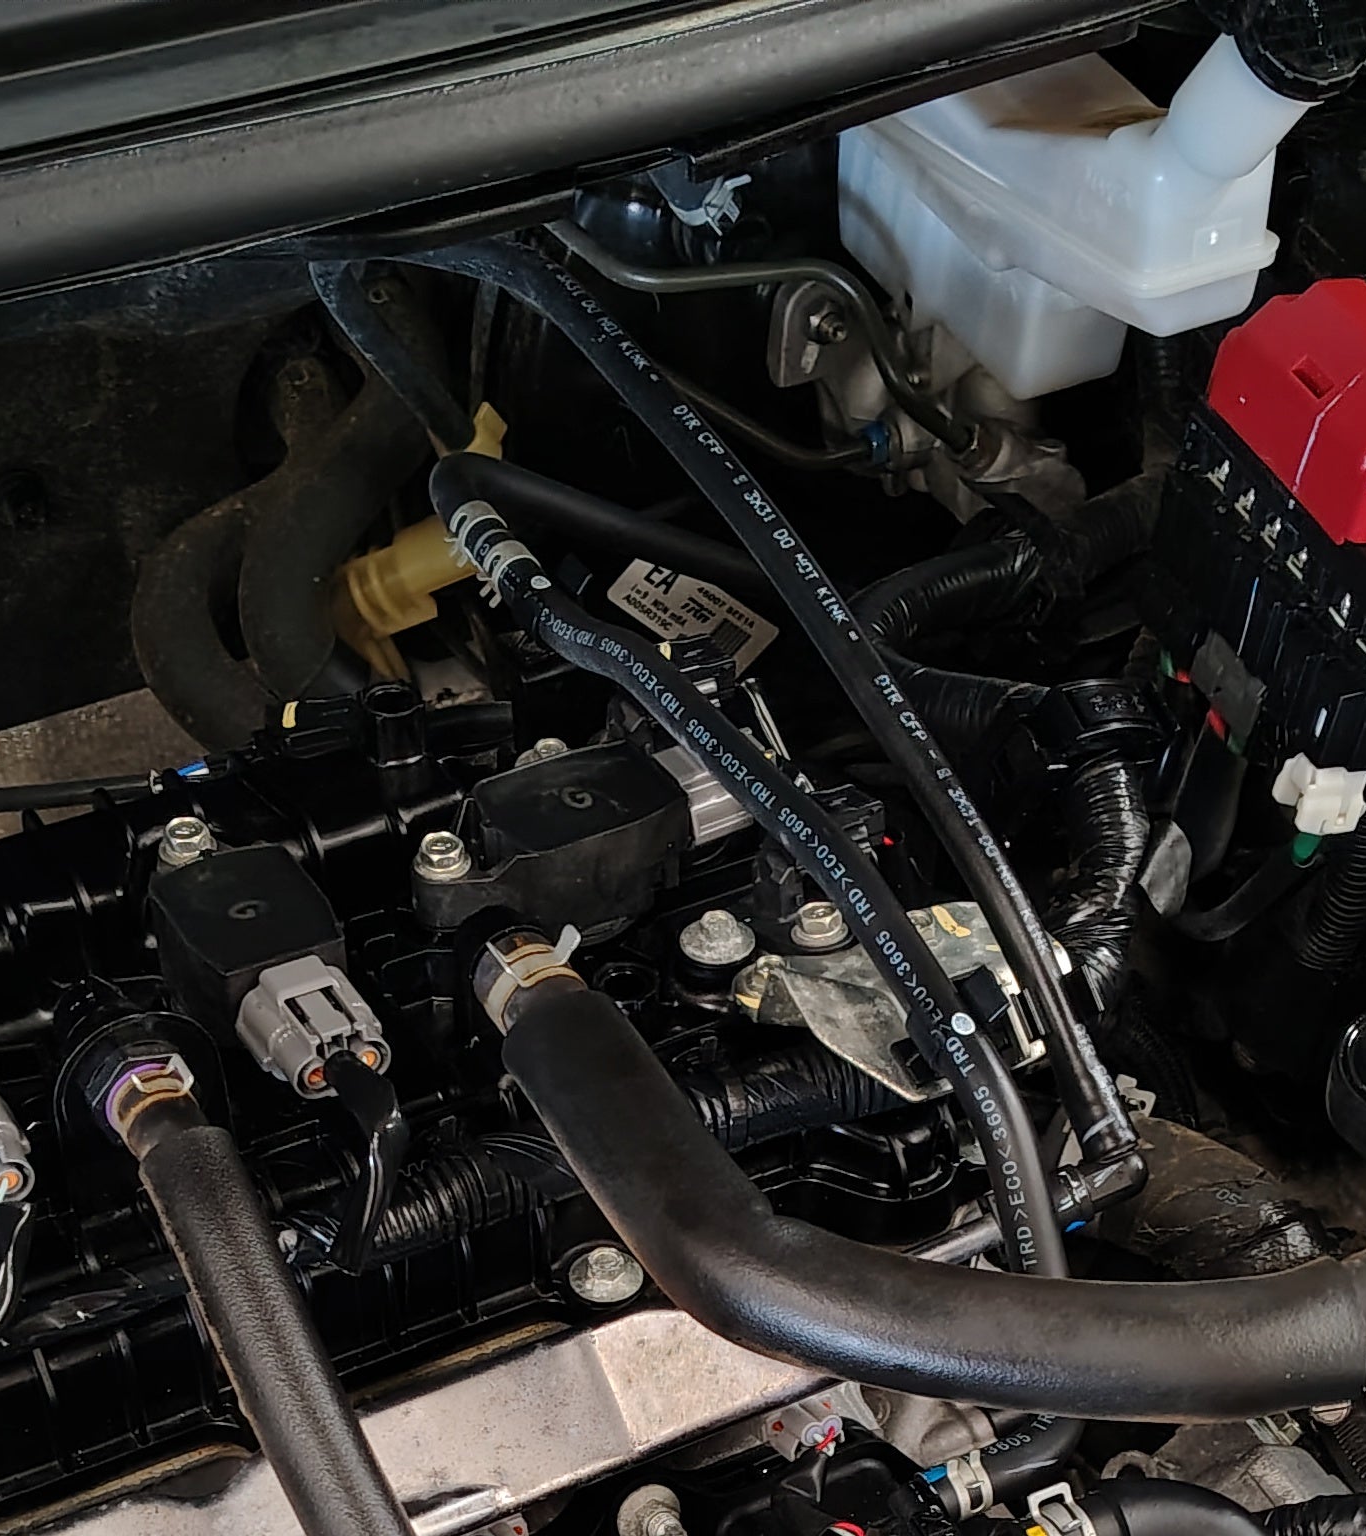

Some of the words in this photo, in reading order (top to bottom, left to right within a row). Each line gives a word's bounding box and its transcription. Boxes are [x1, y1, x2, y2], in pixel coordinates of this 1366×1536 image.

[644, 564, 678, 595] EA
[697, 431, 725, 455] CFP
[816, 586, 850, 626] KINK
[685, 718, 777, 810] TRD>ECO<3605
[777, 806, 877, 927] TRD>ECO<3605
[973, 1085, 1038, 1271] TRD>ECO<3605
